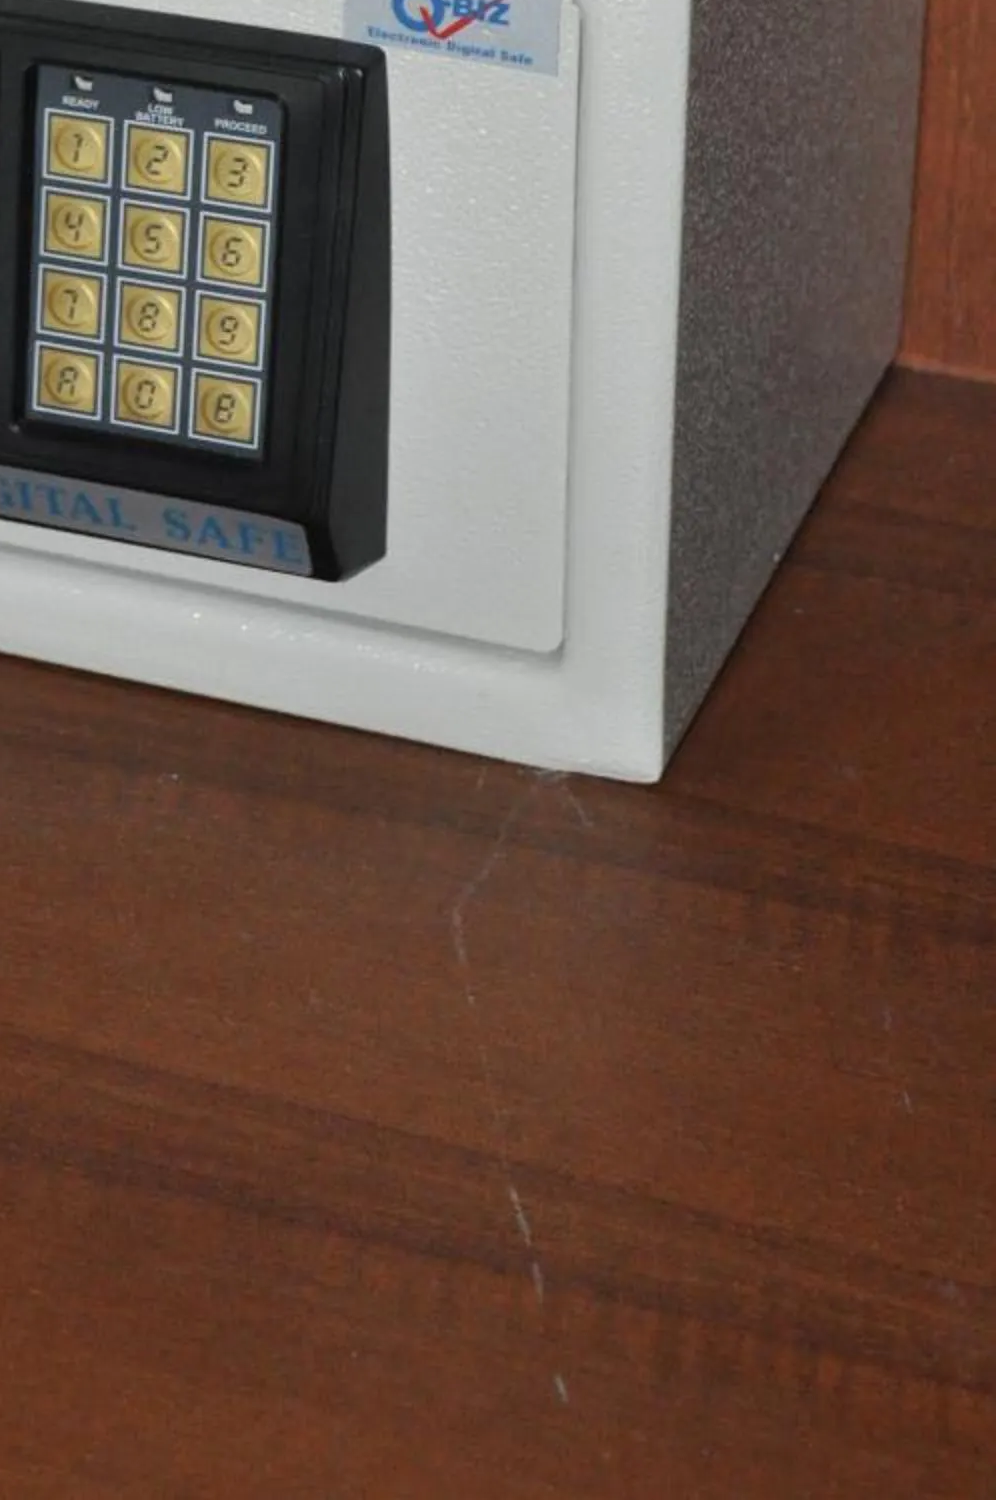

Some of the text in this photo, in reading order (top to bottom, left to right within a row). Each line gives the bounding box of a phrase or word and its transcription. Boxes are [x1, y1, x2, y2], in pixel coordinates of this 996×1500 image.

[367, 25, 533, 66] Electronic Digital Safe
[61, 95, 100, 111] READY
[148, 102, 174, 116] LOW
[135, 111, 184, 128] BATTERY
[214, 117, 268, 136] PROCEED
[146, 144, 169, 175] 2
[227, 157, 247, 188] 3
[65, 211, 84, 242] 4
[144, 224, 163, 254] 5
[221, 237, 242, 268] 6
[63, 289, 78, 320] 7
[137, 302, 159, 332] 8
[219, 315, 238, 345] 9
[162, 505, 304, 563] SAFE
